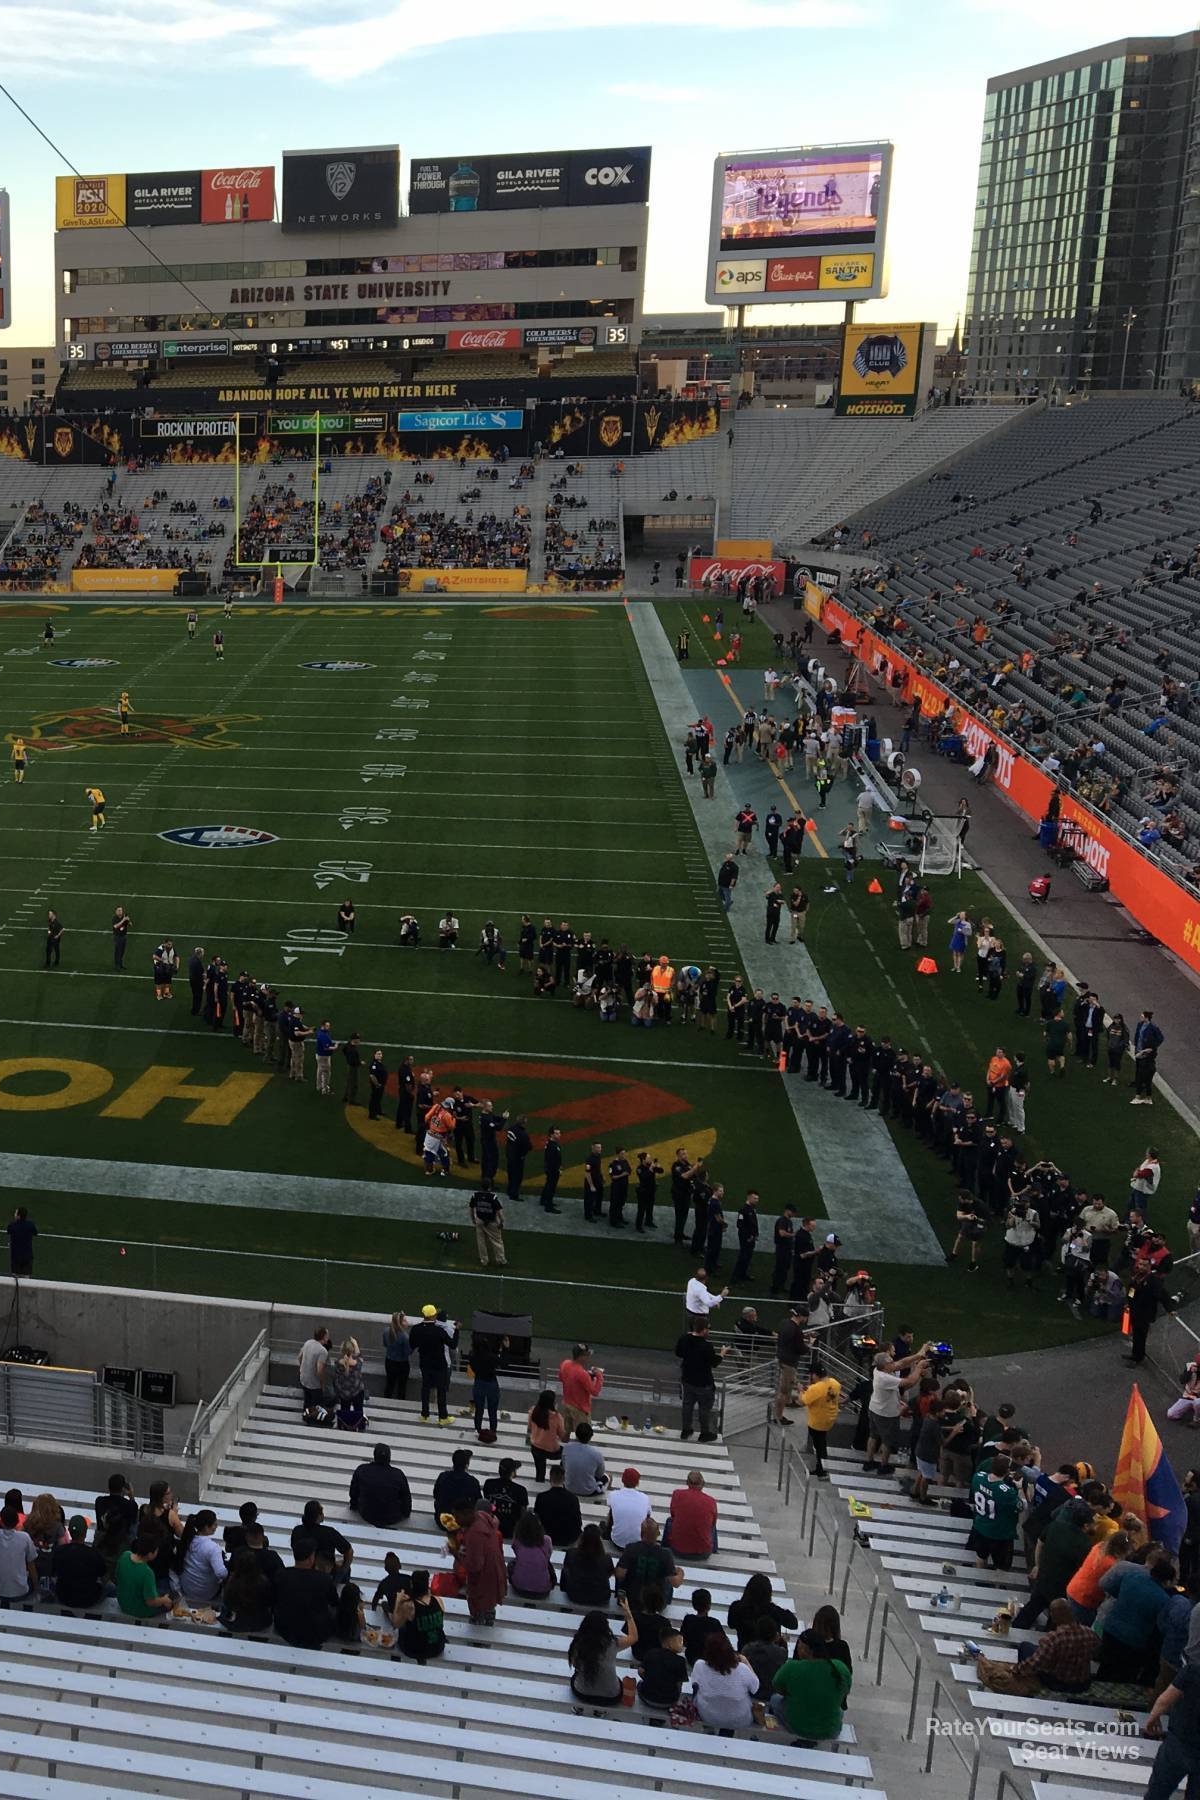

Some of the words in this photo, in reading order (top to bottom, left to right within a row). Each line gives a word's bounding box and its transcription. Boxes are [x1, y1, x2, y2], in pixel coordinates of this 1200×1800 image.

[211, 170, 262, 190] Coca-Cola
[417, 171, 442, 180] POWER
[497, 170, 524, 180] GILA
[526, 168, 561, 178] RIVER
[585, 164, 633, 187] COX
[412, 180, 446, 190] THROUGH
[77, 189, 105, 203] ASU
[134, 188, 159, 198] GILA
[161, 187, 192, 197] RIVER
[77, 203, 106, 214] 2020
[298, 212, 382, 224] NETWORKS
[736, 269, 762, 284] aps
[825, 267, 845, 275] SAN
[848, 265, 868, 273] TAN
[230, 286, 295, 304] ARIZONA
[304, 284, 349, 301] STATE
[357, 280, 451, 299] UNIVERSITY
[460, 331, 508, 347] Coca-Cola
[526, 329, 545, 337] COLD
[609, 328, 626, 342] 35
[69, 345, 85, 358] 35
[169, 344, 227, 354] enterprise
[271, 343, 277, 353] 0
[288, 343, 293, 351] 3
[331, 339, 349, 349] 4:57
[382, 340, 387, 348] 3
[403, 339, 409, 349] 0
[218, 390, 272, 402] ABANDON
[276, 388, 306, 400] HOPE
[310, 388, 330, 400] ALL
[335, 387, 349, 399] YE
[352, 386, 379, 399] WHO
[383, 386, 421, 399] ENTER
[425, 384, 457, 397] HERE
[846, 404, 906, 415] HOTSHOTS
[277, 419, 300, 430] YOU
[302, 419, 318, 429] DO
[322, 418, 343, 429] YOU
[414, 415, 459, 429] Sagicor
[464, 413, 487, 426] Life
[157, 422, 196, 436] ROCKIN'
[197, 421, 238, 435] PROTEIN
[701, 562, 777, 591] Coca-Co
[90, 607, 454, 616] HOTSHOTS
[961, 718, 1016, 789] HOTSOTS
[338, 806, 391, 825] 30
[313, 860, 373, 882] 20
[280, 928, 349, 956] 10
[974, 1491, 995, 1520] 91
